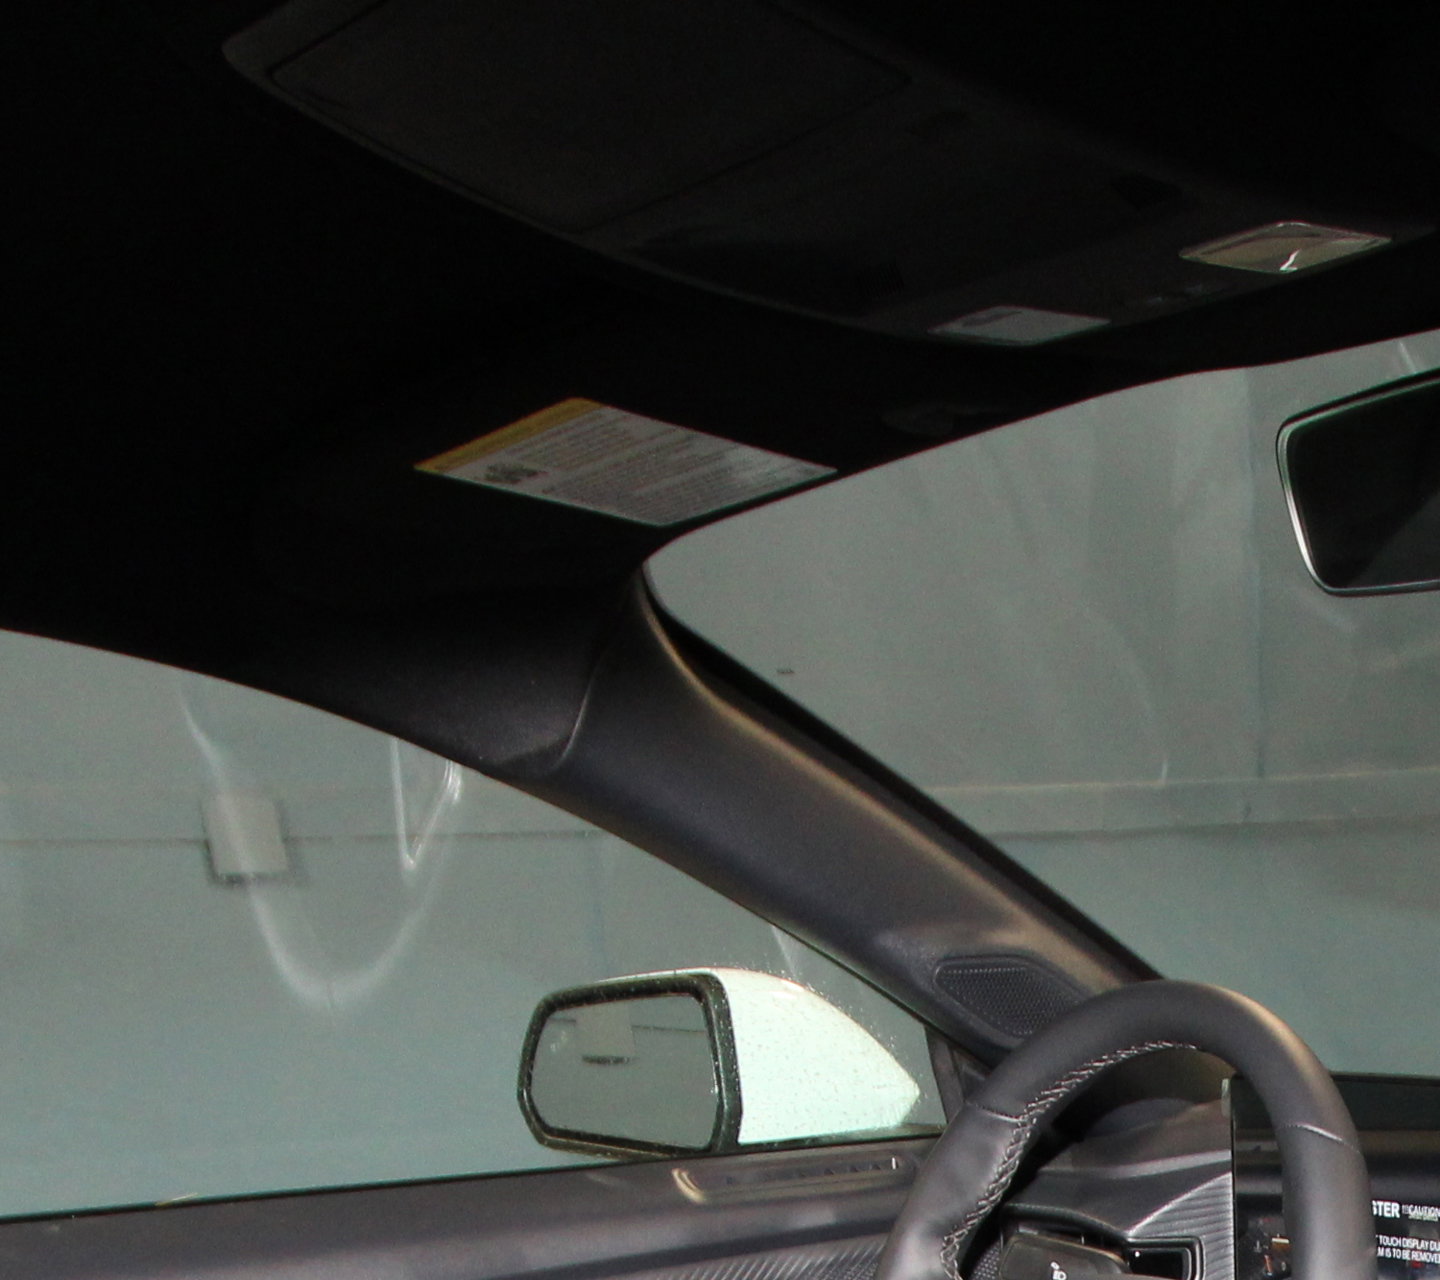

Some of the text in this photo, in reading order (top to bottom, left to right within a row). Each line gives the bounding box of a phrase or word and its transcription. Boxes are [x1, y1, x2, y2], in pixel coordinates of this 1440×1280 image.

[1379, 1234, 1402, 1247] TOUCH
[1402, 1237, 1429, 1250] DISPLAY
[1392, 1248, 1401, 1259] TO
[1402, 1250, 1411, 1260] BE
